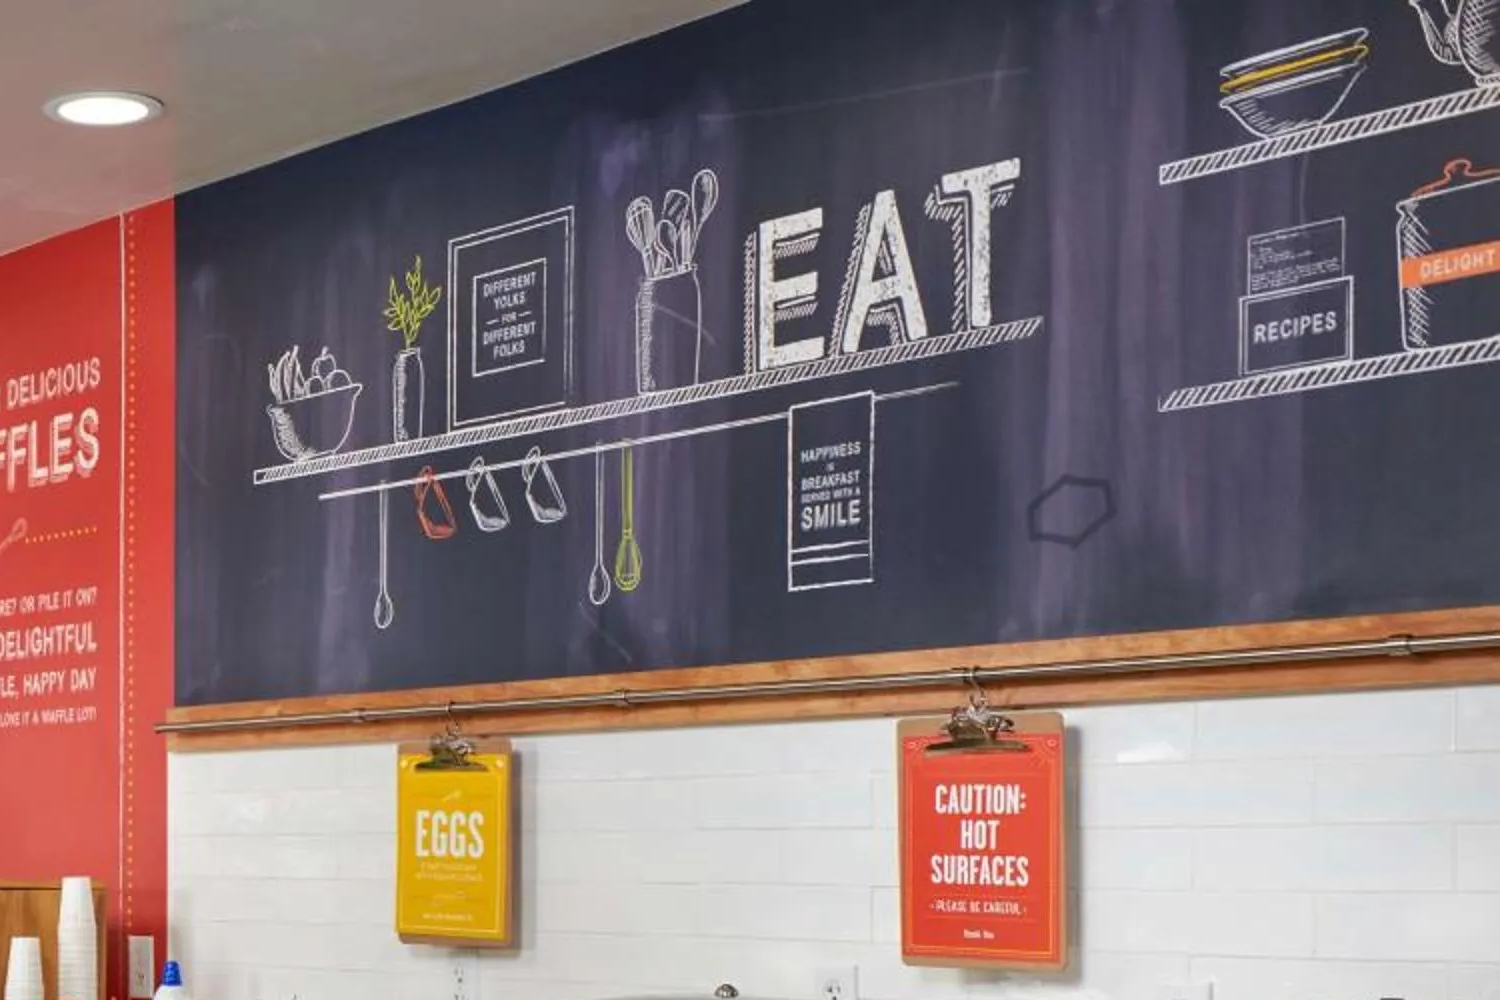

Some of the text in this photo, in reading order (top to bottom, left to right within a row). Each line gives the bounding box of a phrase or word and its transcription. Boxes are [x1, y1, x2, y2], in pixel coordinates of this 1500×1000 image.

[745, 157, 1021, 374] EAT
[1419, 249, 1496, 280] DELIGHT
[483, 271, 537, 297] DIFFERENT
[493, 291, 526, 310] YOLKS
[501, 311, 517, 323] FOR
[1253, 311, 1337, 344] RECIPES
[483, 321, 537, 345] DIFFERENT
[493, 339, 526, 360] FOLKS
[6, 357, 100, 410] DELICIOUS
[801, 441, 861, 463] HAPPINESS
[801, 470, 860, 492] BREAKFAST
[801, 499, 861, 531] SMILE
[20, 593, 35, 615] OR
[37, 591, 60, 613] PILE
[63, 588, 73, 609] IT
[23, 670, 65, 697] HAPPY
[70, 667, 97, 692] DAY
[0, 711, 21, 728] LOVE
[41, 707, 76, 725] WAFFLE
[934, 783, 1027, 815] CAUTION:
[415, 809, 485, 860] EGGS
[960, 819, 1000, 850] HOT
[930, 854, 1029, 887] SURFACES
[935, 899, 1021, 916] PLEASE BE CAREFUL
